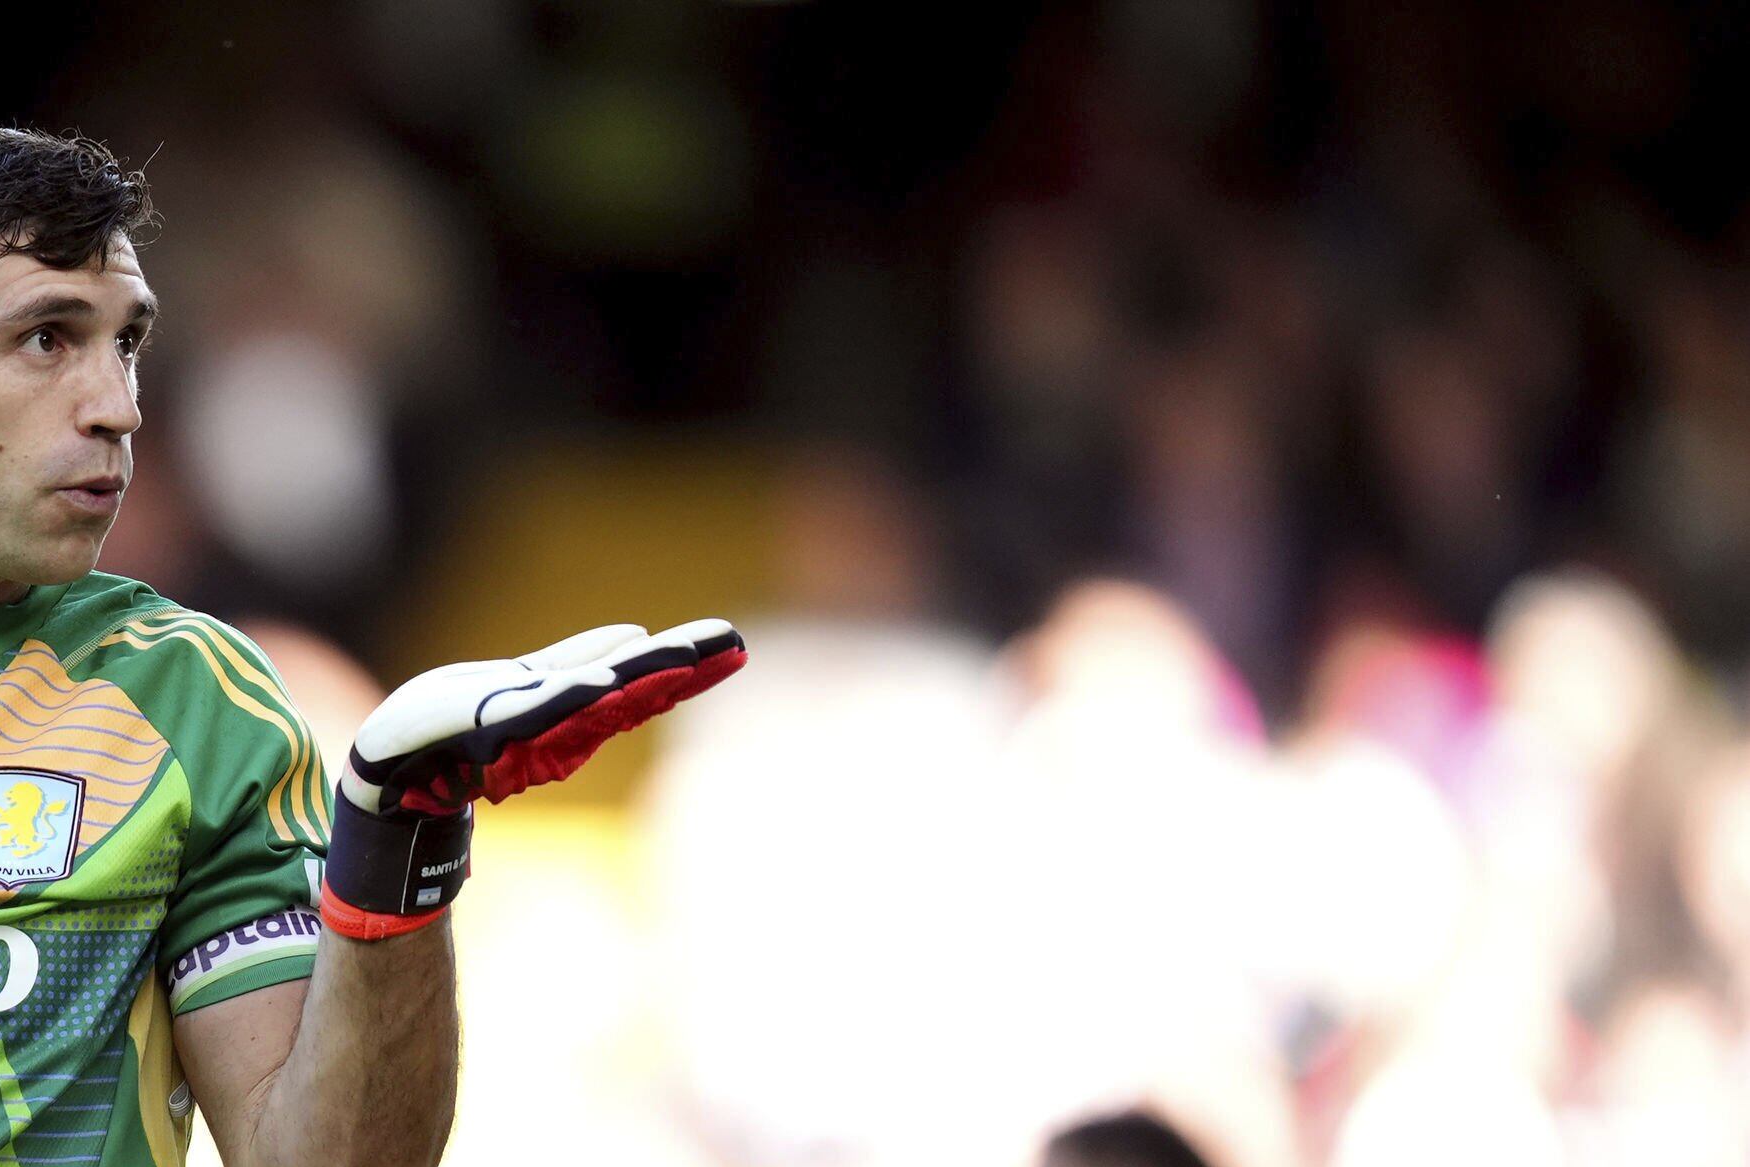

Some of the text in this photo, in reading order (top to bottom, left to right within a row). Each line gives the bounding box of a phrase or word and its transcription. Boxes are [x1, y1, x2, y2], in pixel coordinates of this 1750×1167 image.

[16, 866, 56, 876] VILLA
[421, 861, 453, 878] SANTI
[168, 904, 322, 991] aptain
